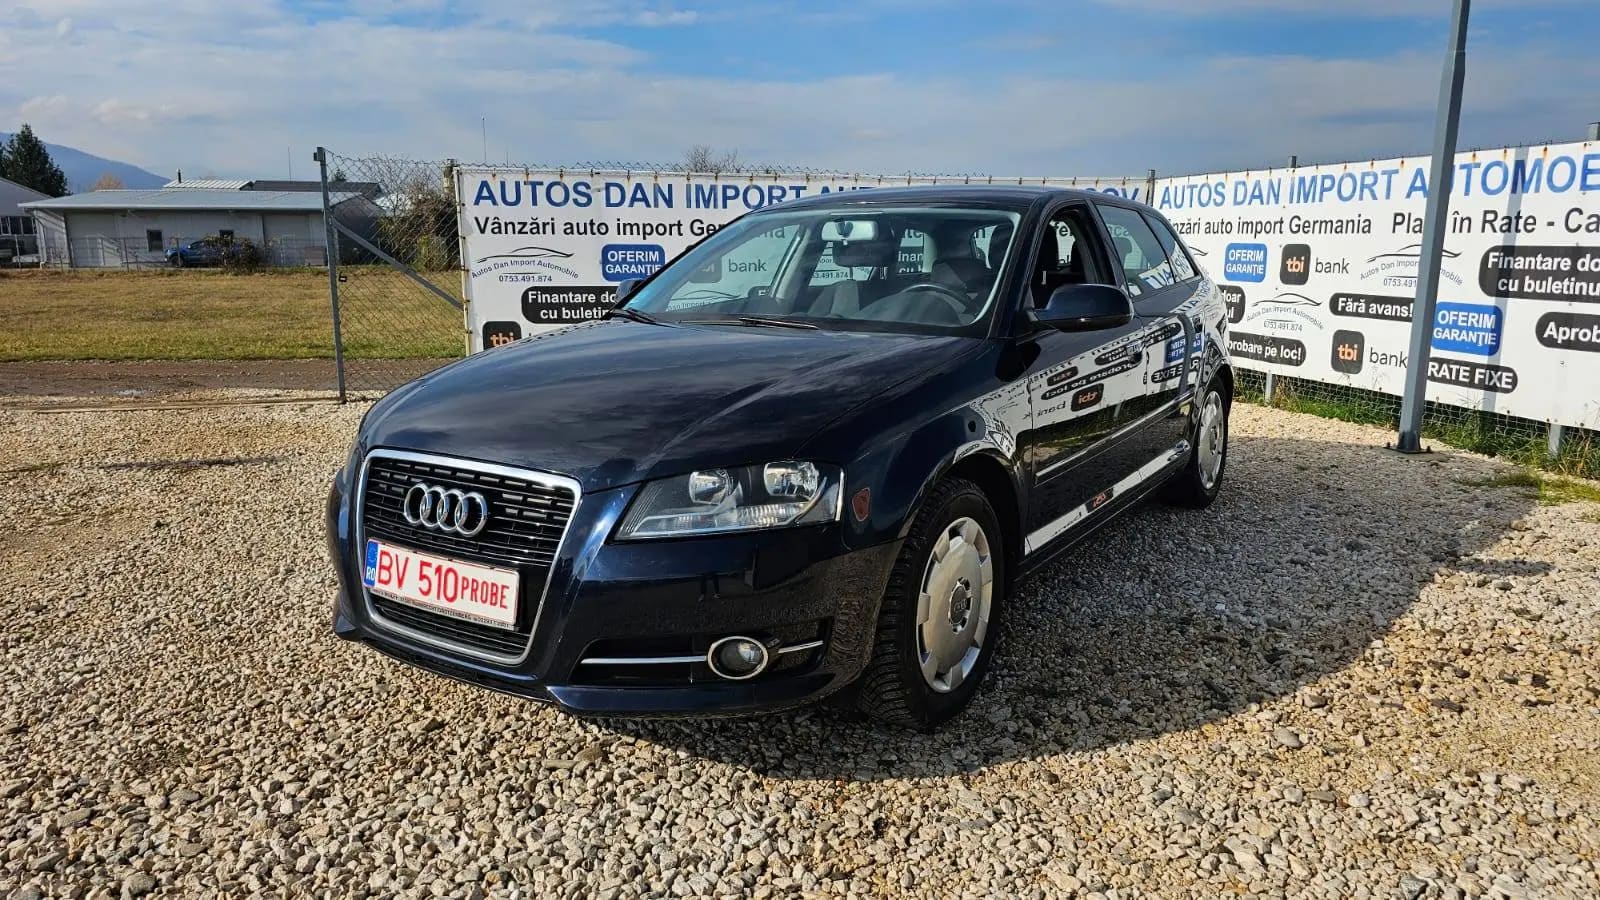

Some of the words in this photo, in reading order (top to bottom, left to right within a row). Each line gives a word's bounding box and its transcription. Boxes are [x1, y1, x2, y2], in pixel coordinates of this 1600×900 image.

[473, 179, 593, 208] AUTOS
[604, 182, 674, 209] DAN
[686, 184, 807, 210] IMPORT
[1159, 180, 1226, 209] AUTOS
[1233, 177, 1281, 206] DAN
[1289, 168, 1400, 204] IMPORT
[474, 216, 556, 236] Vânzări
[563, 218, 609, 236] auto
[617, 218, 684, 241] import
[1204, 218, 1233, 235] auto
[1237, 216, 1285, 239] import
[1289, 213, 1372, 236] Germania
[1452, 210, 1472, 234] în
[1481, 209, 1537, 234] Rate
[608, 251, 660, 263] OFERIM
[1228, 249, 1264, 262] OFERIM
[1286, 256, 1305, 274] tbi
[1315, 257, 1350, 275] bank
[1487, 251, 1573, 272] Finantare
[471, 265, 493, 280] Autos
[493, 262, 509, 271] Dan
[510, 259, 536, 269] Import
[537, 258, 579, 280] Automobile
[728, 259, 767, 273] bank
[1359, 268, 1380, 281] Autos
[1380, 261, 1395, 271] Dan
[1396, 259, 1419, 268] Impor
[498, 274, 553, 283] 0753.491.874
[1497, 278, 1519, 292] cu
[528, 290, 597, 304] Finantare
[540, 309, 558, 320] cu
[1337, 297, 1366, 313] Fără
[1368, 300, 1414, 318] avans!
[1437, 310, 1497, 329] OFERIM
[1264, 346, 1277, 359] pe
[1279, 344, 1302, 361] loc!
[1337, 343, 1358, 362] tbi
[1369, 345, 1408, 369] bank
[1427, 360, 1471, 382] RATE
[1474, 367, 1514, 390] FIXE
[365, 567, 376, 582] RO
[377, 549, 409, 590] BV
[417, 559, 459, 603] 510
[460, 575, 510, 610] PROBE
